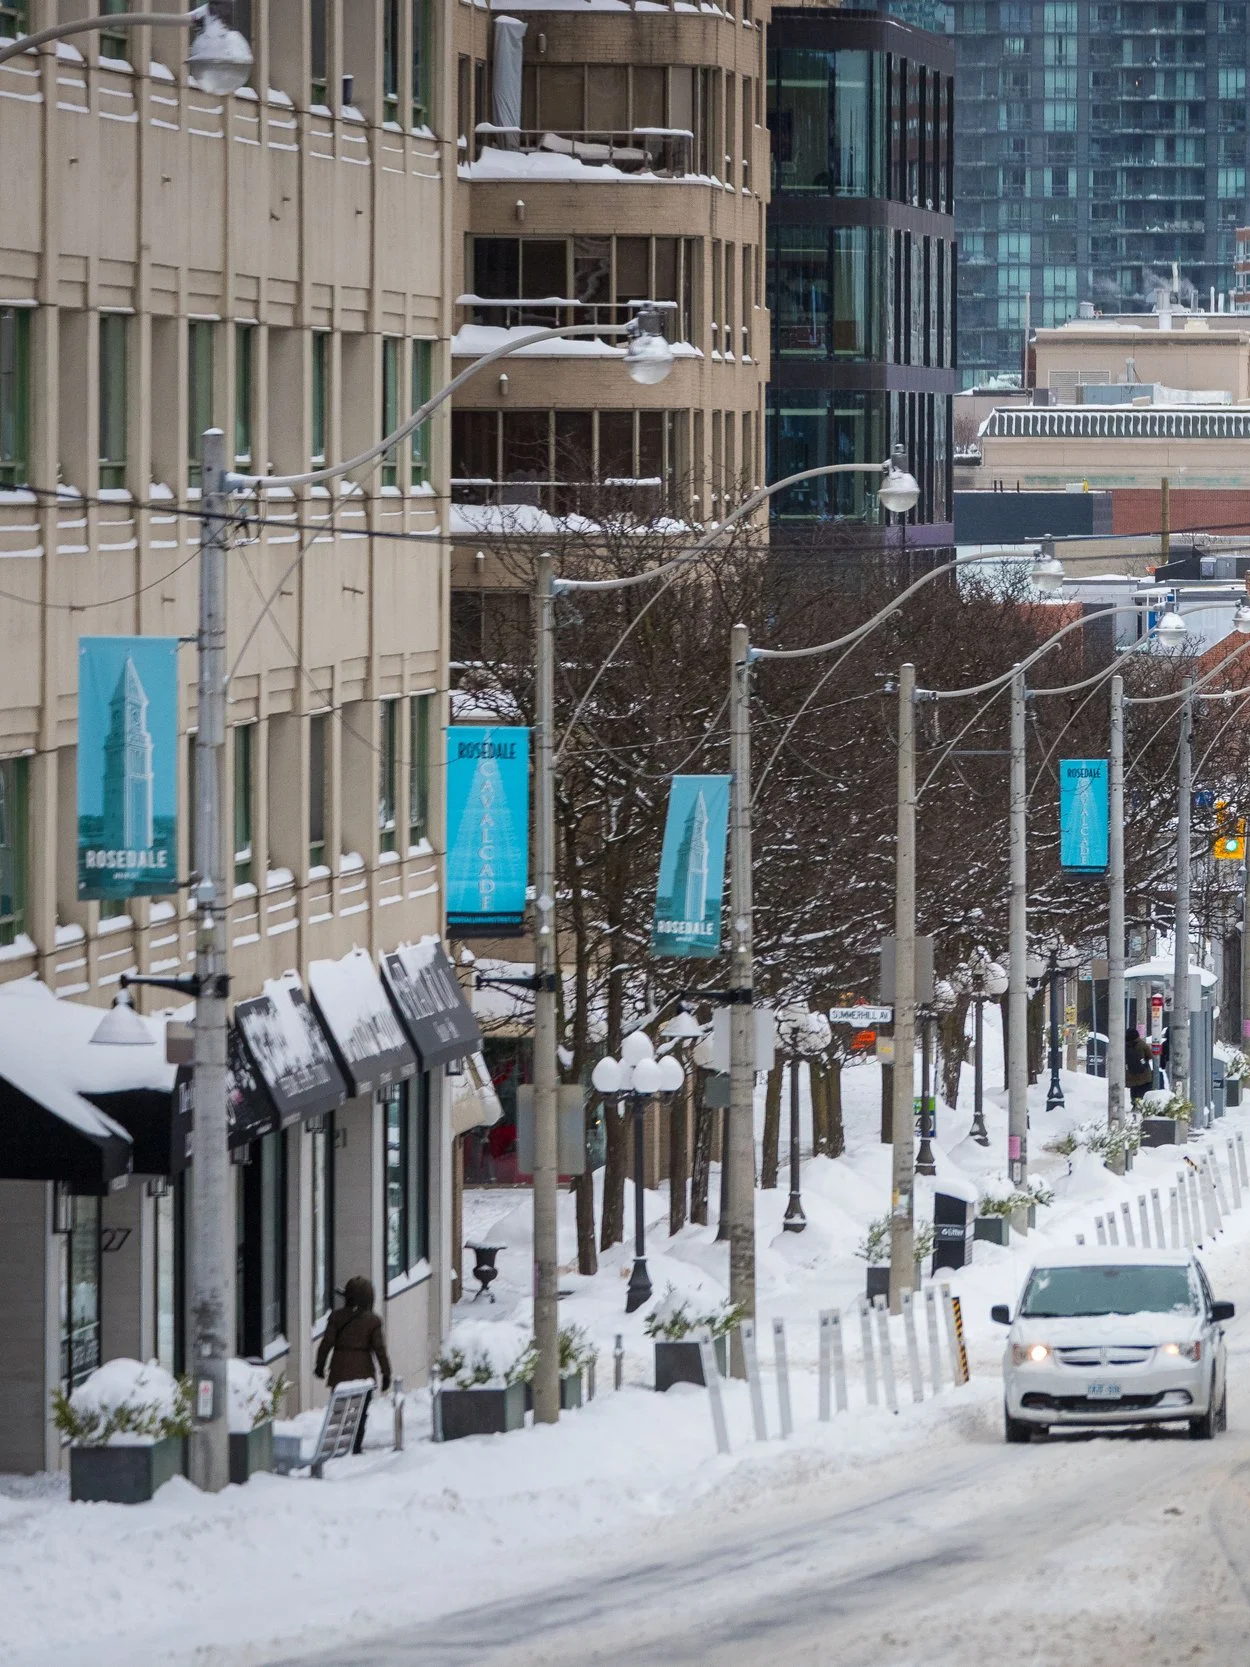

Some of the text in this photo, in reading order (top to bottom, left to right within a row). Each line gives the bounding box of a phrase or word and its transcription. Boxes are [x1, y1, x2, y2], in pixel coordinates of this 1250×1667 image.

[458, 742, 517, 759] ROSEDALE
[1067, 768, 1102, 778] ROSEDALE
[477, 761, 496, 911] CAVALCADE
[86, 849, 168, 869] ROSEDALE
[657, 920, 714, 935] ROSEDALE
